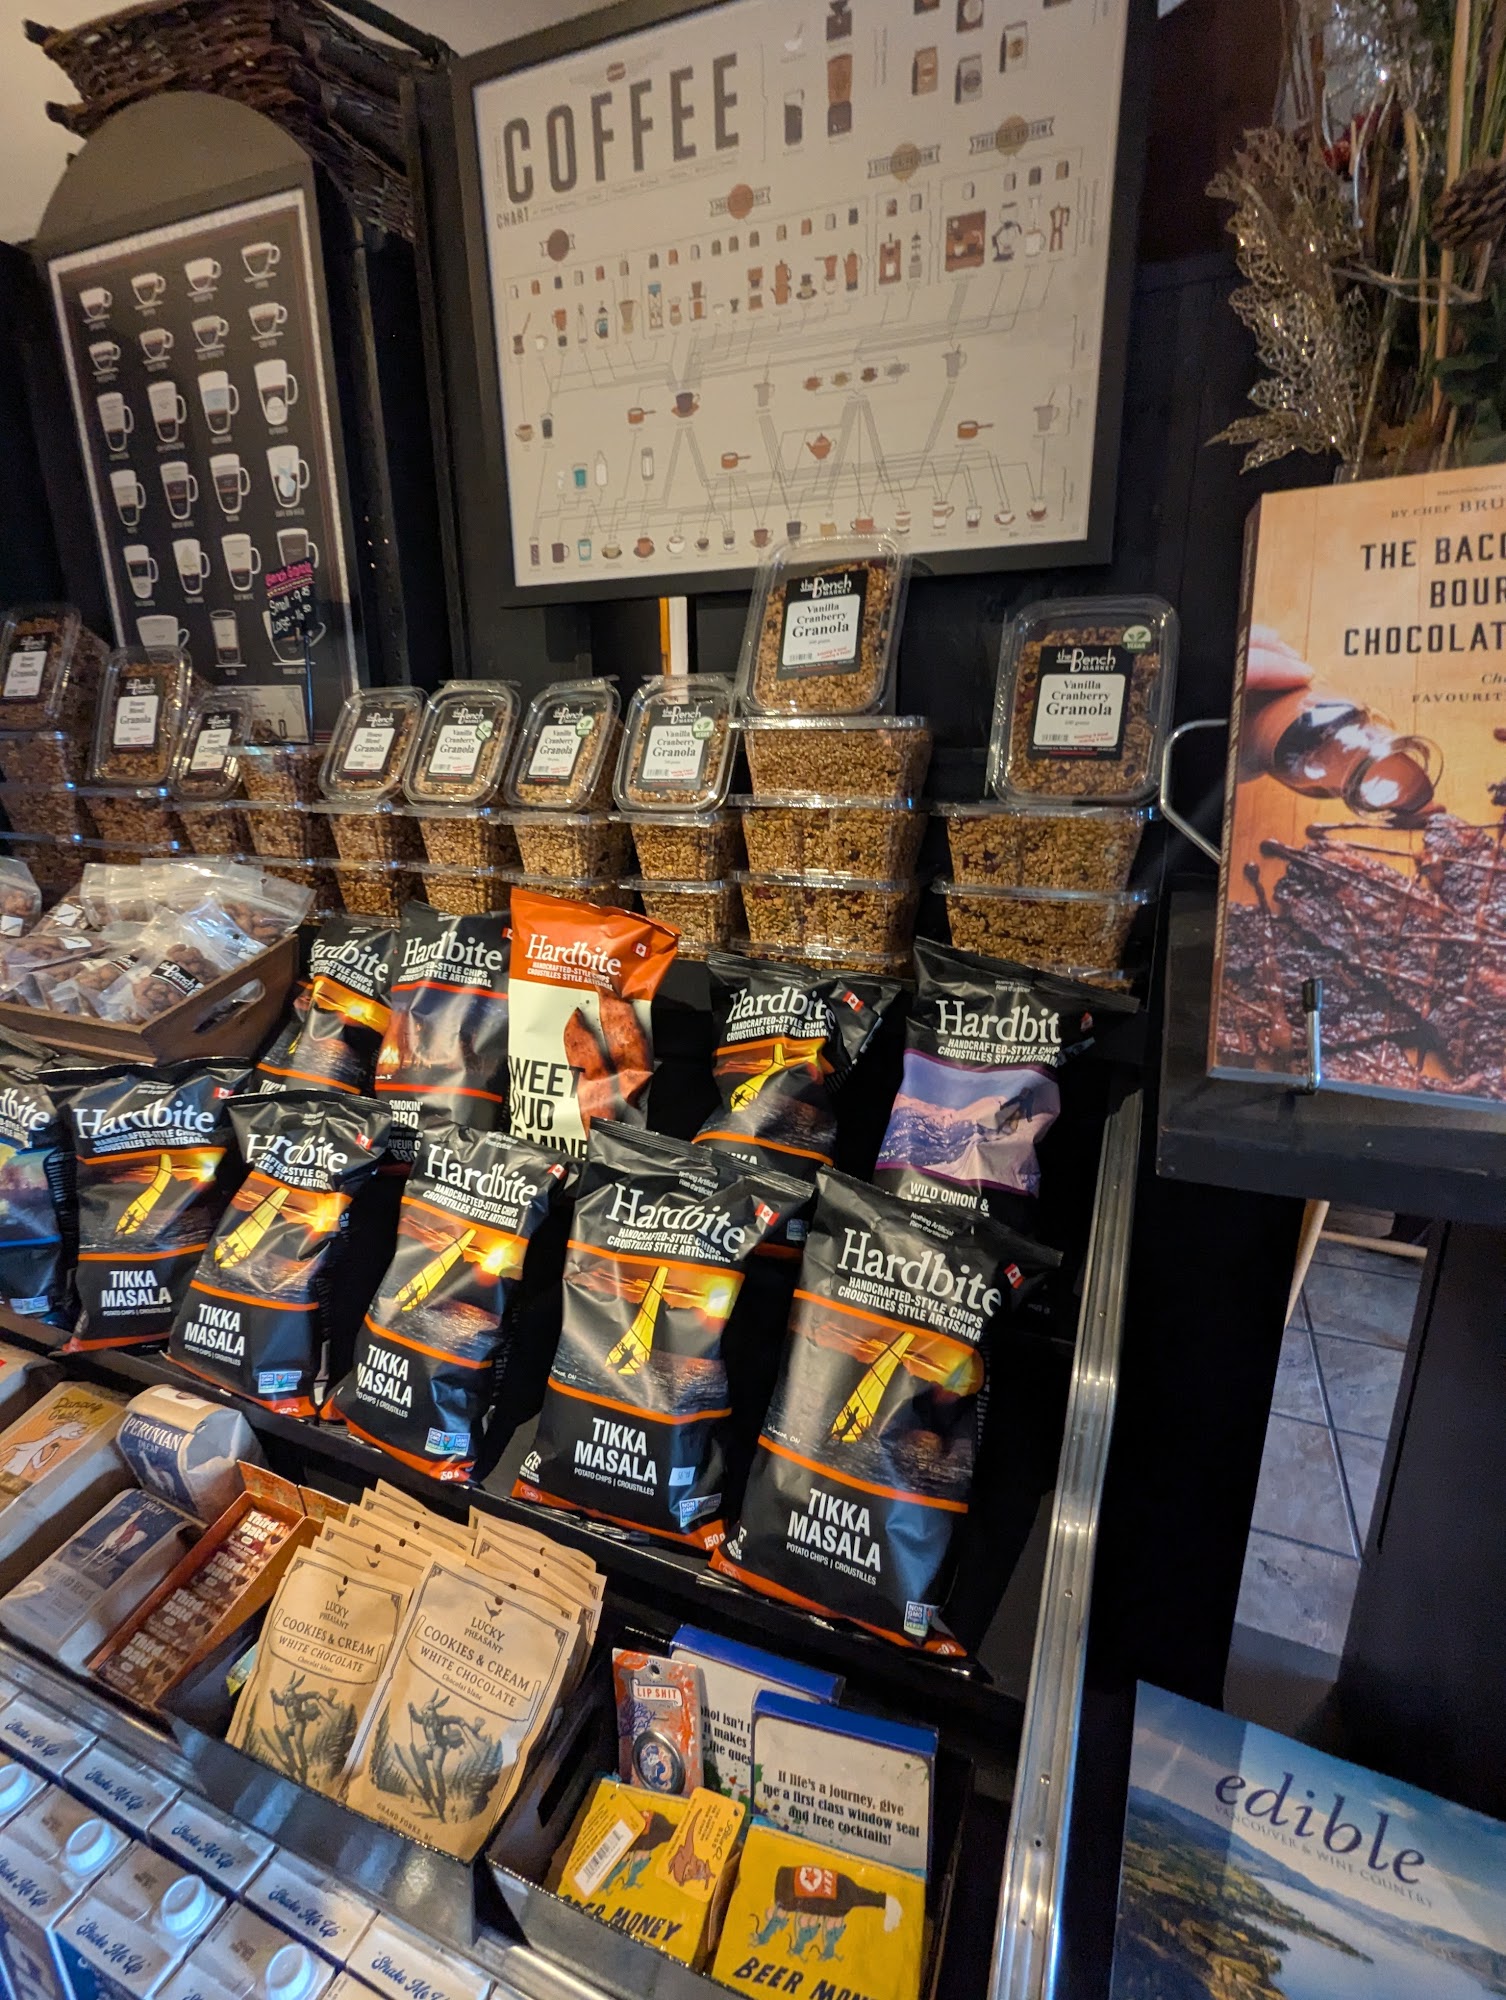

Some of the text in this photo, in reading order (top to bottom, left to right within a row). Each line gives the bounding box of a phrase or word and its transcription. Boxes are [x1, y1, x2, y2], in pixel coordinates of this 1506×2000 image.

[503, 52, 739, 203] COFFEE
[496, 206, 531, 230] CHART
[1413, 504, 1452, 517] CHEF
[1360, 540, 1418, 571] THE
[800, 578, 814, 592] the
[796, 612, 848, 625] Cranberry
[806, 602, 840, 614] Vanilla
[792, 621, 850, 638] Granola
[1343, 621, 1506, 657] CHOCOLAT
[1056, 647, 1117, 673] the Bench
[1082, 664, 1115, 672] MARKET
[1051, 690, 1111, 703] Cranberry
[1064, 680, 1101, 690] Vanilla
[1046, 702, 1112, 716] Granola
[444, 736, 476, 745] Cranberry
[544, 737, 574, 746] Cranberry
[656, 738, 696, 747] Cranberry
[665, 730, 691, 738] Vanilla
[354, 744, 385, 754] Granola
[439, 743, 475, 755] Granola
[539, 745, 573, 755] Granola
[652, 746, 697, 758] Granola
[401, 930, 504, 972] Hardbite
[525, 933, 622, 977] Hardbite
[335, 972, 375, 997] ARTISANAL
[424, 968, 493, 988] STYLE ARTISANAL
[462, 967, 488, 979] CHIPS
[562, 973, 583, 983] STYLE
[726, 986, 836, 1030] Hardbite
[726, 1024, 789, 1042] CROUSTILLES STYLE
[731, 1015, 803, 1032] HANDCRAFTED-STYLE
[937, 1045, 1021, 1064] CROUSTILLES STYLE
[948, 1038, 1037, 1055] HANDCRAFTED-STYLE
[72, 1098, 216, 1139] Hardbite
[392, 1111, 420, 1130] BBQ
[424, 1143, 539, 1207] Hardbite
[422, 1189, 471, 1215] CROUSTILLES
[469, 1206, 489, 1221] STYLE
[433, 1183, 519, 1218] HANDCRAFTED-STYLE CHIPS
[909, 1182, 939, 1201] WILD
[940, 1188, 978, 1211] ONION
[980, 1198, 991, 1212] &
[605, 1182, 746, 1254] Hardbite
[910, 1211, 955, 1237] Nothing Artificial
[607, 1235, 678, 1255] CROUSTILLES STYLE
[618, 1227, 695, 1246] HANDCRAFTED-STYLE
[109, 1269, 159, 1288] TIKKA
[836, 1227, 1002, 1317] Hardbite
[101, 1284, 173, 1308] MASALA
[837, 1285, 897, 1313] CROUSTILLES
[897, 1303, 927, 1322] STYLE
[848, 1276, 984, 1330] HANDCRAFTED-STYLE CHIPS
[198, 1303, 241, 1333] TIKKA
[184, 1321, 246, 1357] MASALA
[365, 1343, 410, 1382] TIKKA
[379, 1398, 409, 1419] CROUSTILLES
[123, 1417, 184, 1452] PERUVIAN
[592, 1417, 648, 1457] TIKKA
[523, 1450, 542, 1472] GF
[573, 1440, 658, 1485] MASALA
[574, 1467, 655, 1497] POTATO CHIPS CROUSTILLES
[246, 1510, 279, 1533] Third
[807, 1487, 871, 1537] TIKKA
[239, 1522, 269, 1542] Date
[704, 1534, 720, 1550] 150
[787, 1510, 882, 1573] MASALA
[786, 1542, 877, 1586] POTATO CHIPS CROUSTILLES
[324, 1600, 350, 1619] LUCKY
[908, 1604, 923, 1612] NON
[318, 1611, 350, 1631] PHEASANT
[471, 1616, 506, 1642] LUCKY
[282, 1615, 376, 1658] COOKIES & CREAM
[464, 1627, 504, 1653] PHEASANT
[278, 1635, 364, 1674] WHITE CHOCOLATE
[297, 1655, 334, 1675] Chocolat blanc
[423, 1625, 531, 1693] COOKIES & CREAM
[419, 1645, 518, 1708] WHITE CHOCOLATE
[441, 1672, 484, 1702] Chocolat blanc
[636, 1686, 679, 1701] LIP SHIT
[722, 1711, 744, 1731] isn't
[713, 1727, 748, 1749] makes
[778, 1769, 905, 1817] If life's a journey, give
[763, 1782, 921, 1839] me a first class window seat
[787, 1804, 892, 1847] and free cocktails!
[1214, 1771, 1426, 1885] edible
[1213, 1804, 1434, 1908] VANCOUVER WINE COUNTRY
[610, 1906, 683, 1942] MONEY
[371, 1957, 408, 1985] Shake
[732, 1956, 805, 1995] BEER
